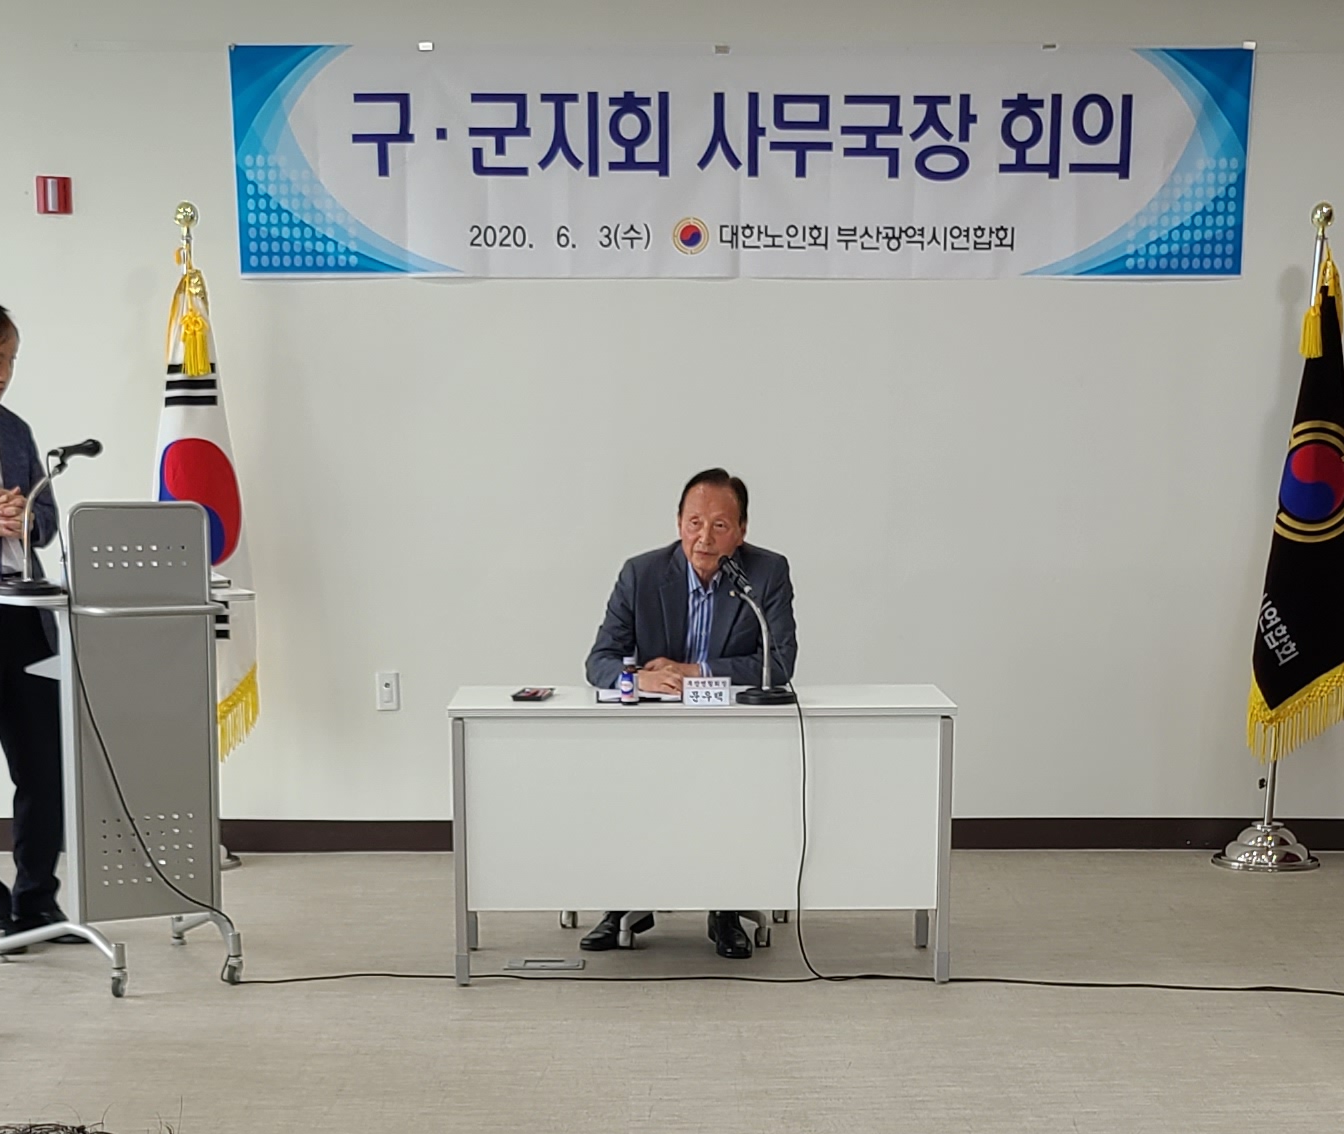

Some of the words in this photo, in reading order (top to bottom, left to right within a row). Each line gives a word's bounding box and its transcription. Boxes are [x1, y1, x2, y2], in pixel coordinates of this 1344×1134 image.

[696, 91, 978, 181] 사무국장
[998, 93, 1134, 180] 회의
[469, 224, 534, 249] 2020.
[556, 225, 577, 249] 6.
[599, 223, 651, 251] 3(수)
[719, 223, 829, 251] 대한노인회
[836, 224, 1015, 252] 부산광역시연합회
